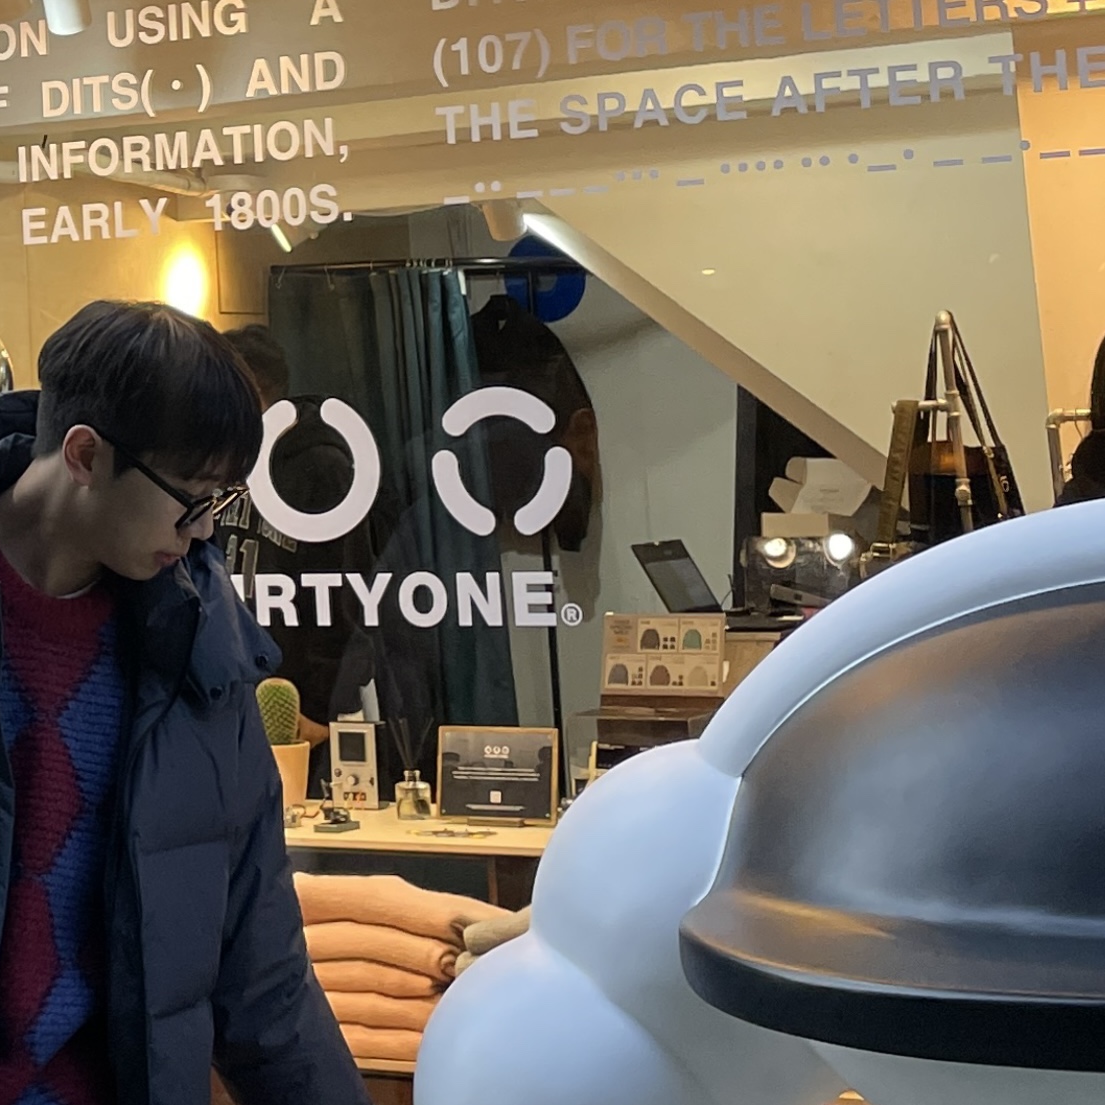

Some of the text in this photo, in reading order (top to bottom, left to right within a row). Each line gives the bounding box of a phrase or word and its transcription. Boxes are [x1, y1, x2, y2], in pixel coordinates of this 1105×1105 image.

[107, 0, 248, 48] USING
[309, 0, 344, 26] A
[433, 28, 551, 87] (107)
[566, 15, 667, 65] FOR
[681, 4, 785, 52] THE
[245, 51, 346, 98] AND
[435, 46, 1105, 144] THE SPACE AFTER THE
[17, 117, 350, 183] INFORMATION,
[22, 197, 169, 245] EARLY
[205, 183, 353, 231] 1800S.
